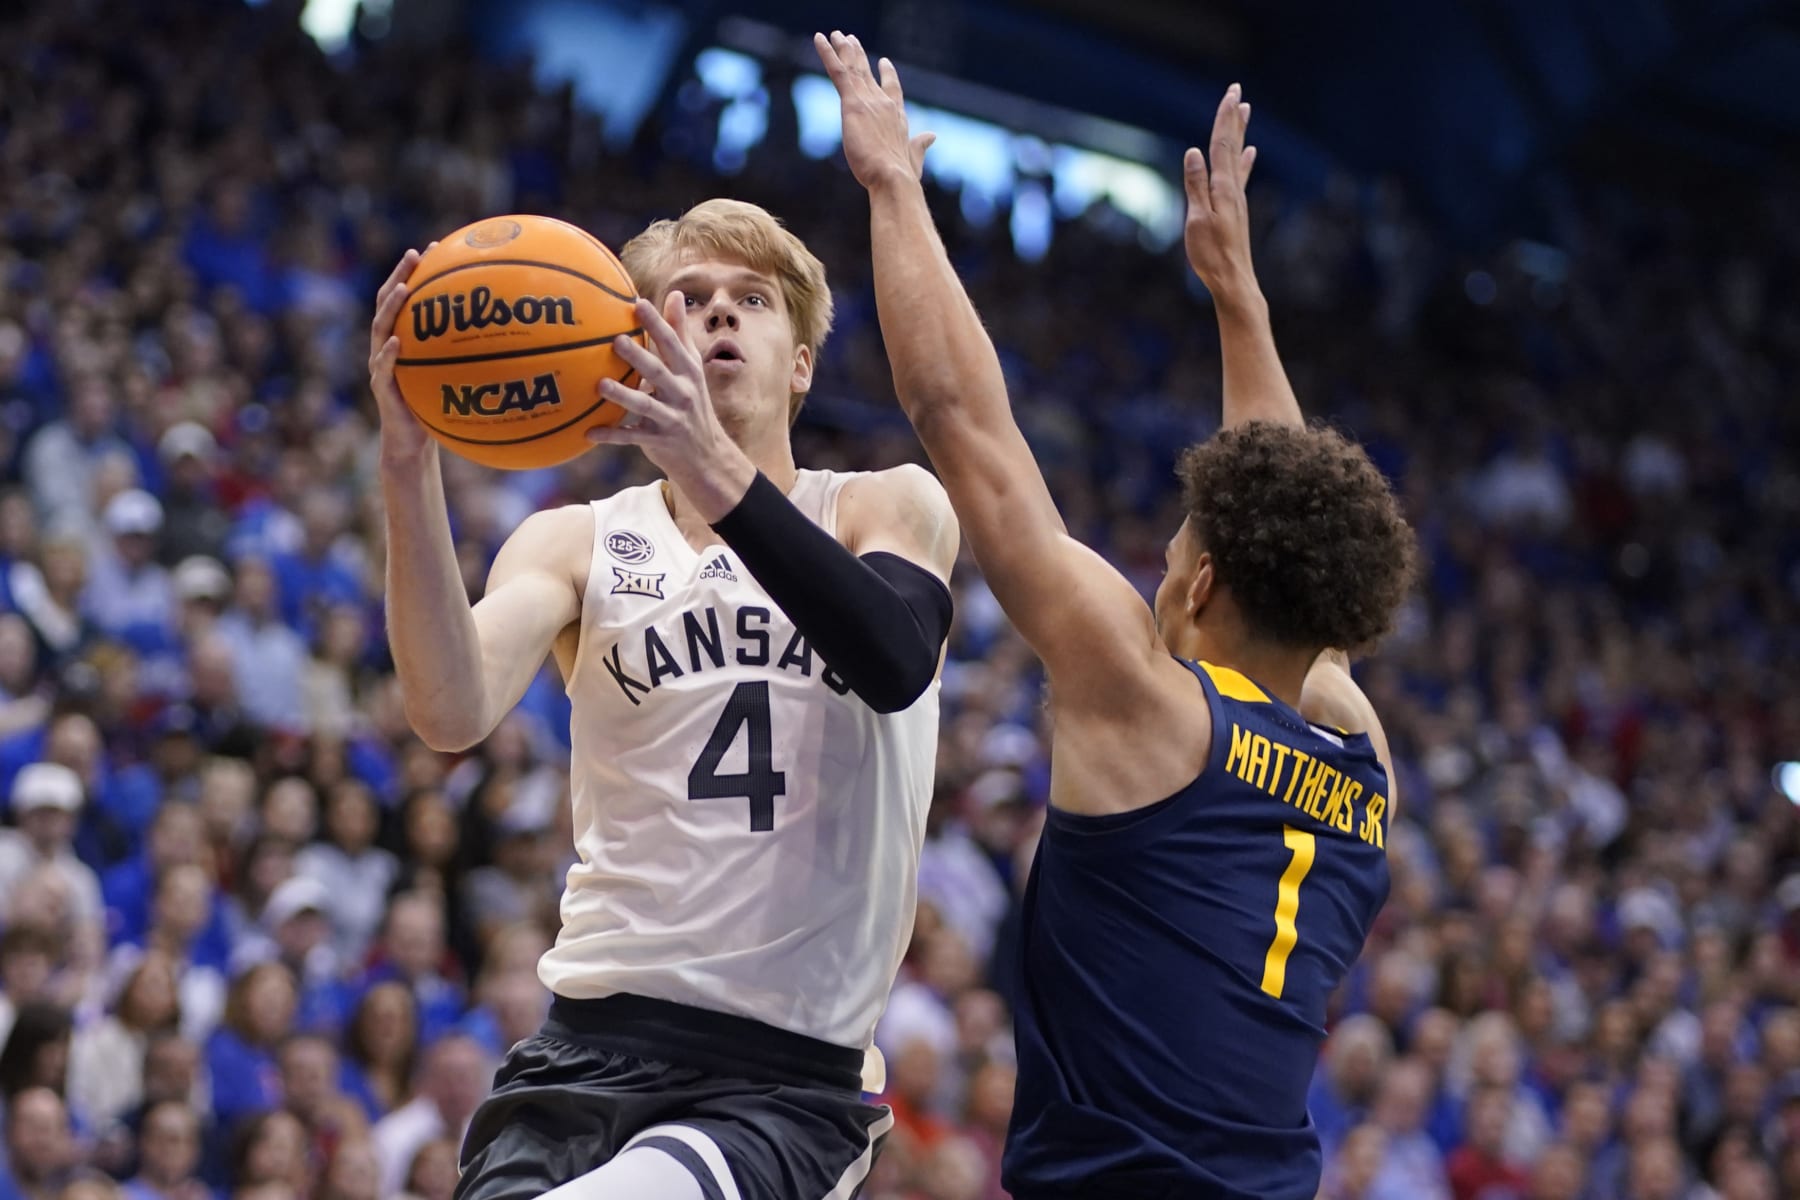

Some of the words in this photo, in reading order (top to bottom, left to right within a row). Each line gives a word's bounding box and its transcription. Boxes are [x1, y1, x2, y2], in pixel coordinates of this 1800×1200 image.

[411, 286, 576, 342] Wilson
[440, 371, 561, 416] NCAA
[610, 537, 634, 552] 125
[610, 566, 666, 600] XII
[700, 567, 738, 583] adidas
[688, 680, 786, 832] 4
[1225, 723, 1363, 834] MATTHEWS
[1359, 791, 1387, 850] JR
[1260, 823, 1316, 1000] 1
